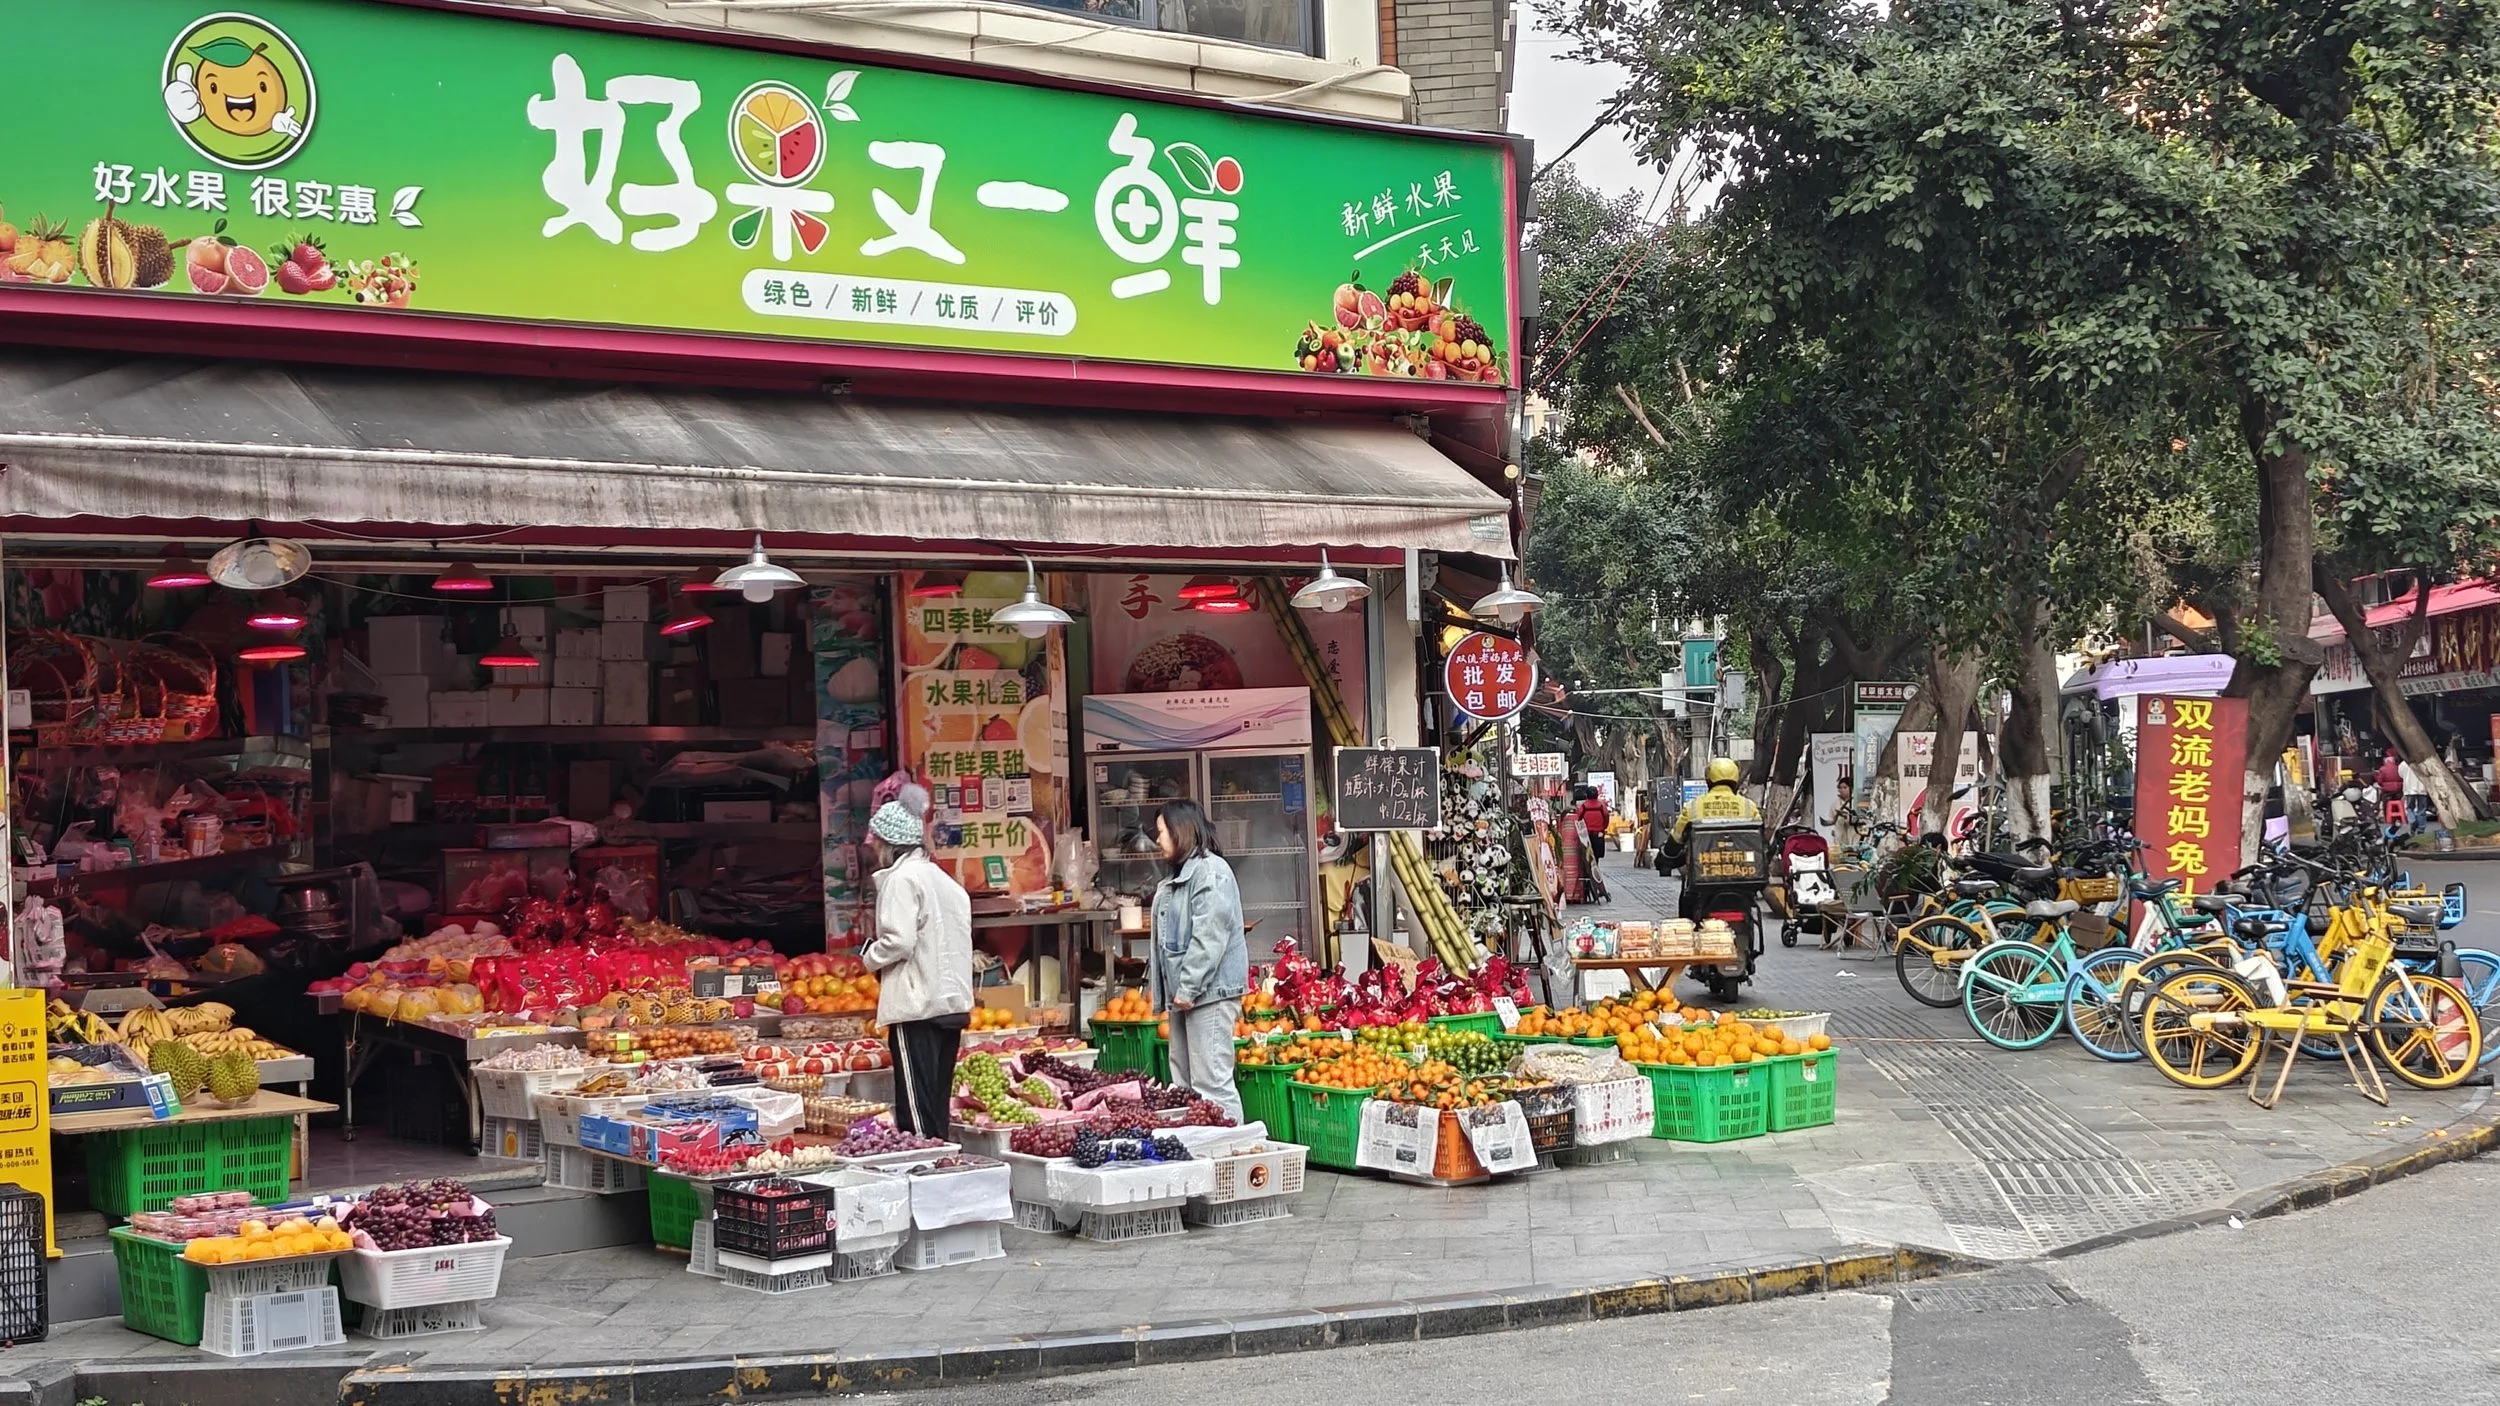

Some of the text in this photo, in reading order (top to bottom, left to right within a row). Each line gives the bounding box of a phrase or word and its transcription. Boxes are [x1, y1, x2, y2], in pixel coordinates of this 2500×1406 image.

[527, 52, 1245, 305] 好果又一鲜
[92, 161, 379, 226] 好水果 很实惠
[1341, 170, 1462, 238] 新鲜水果
[1417, 229, 1481, 269] 天天见
[1463, 663, 1516, 686] 批发
[926, 679, 1022, 706] 水果礼盒
[1465, 690, 1518, 710] 包邮
[929, 750, 1025, 778] 新鲜果甜
[1364, 753, 1426, 778] 鲜榨果汁
[936, 820, 1027, 849] 质平价
[1, 1091, 24, 1104] 美团
